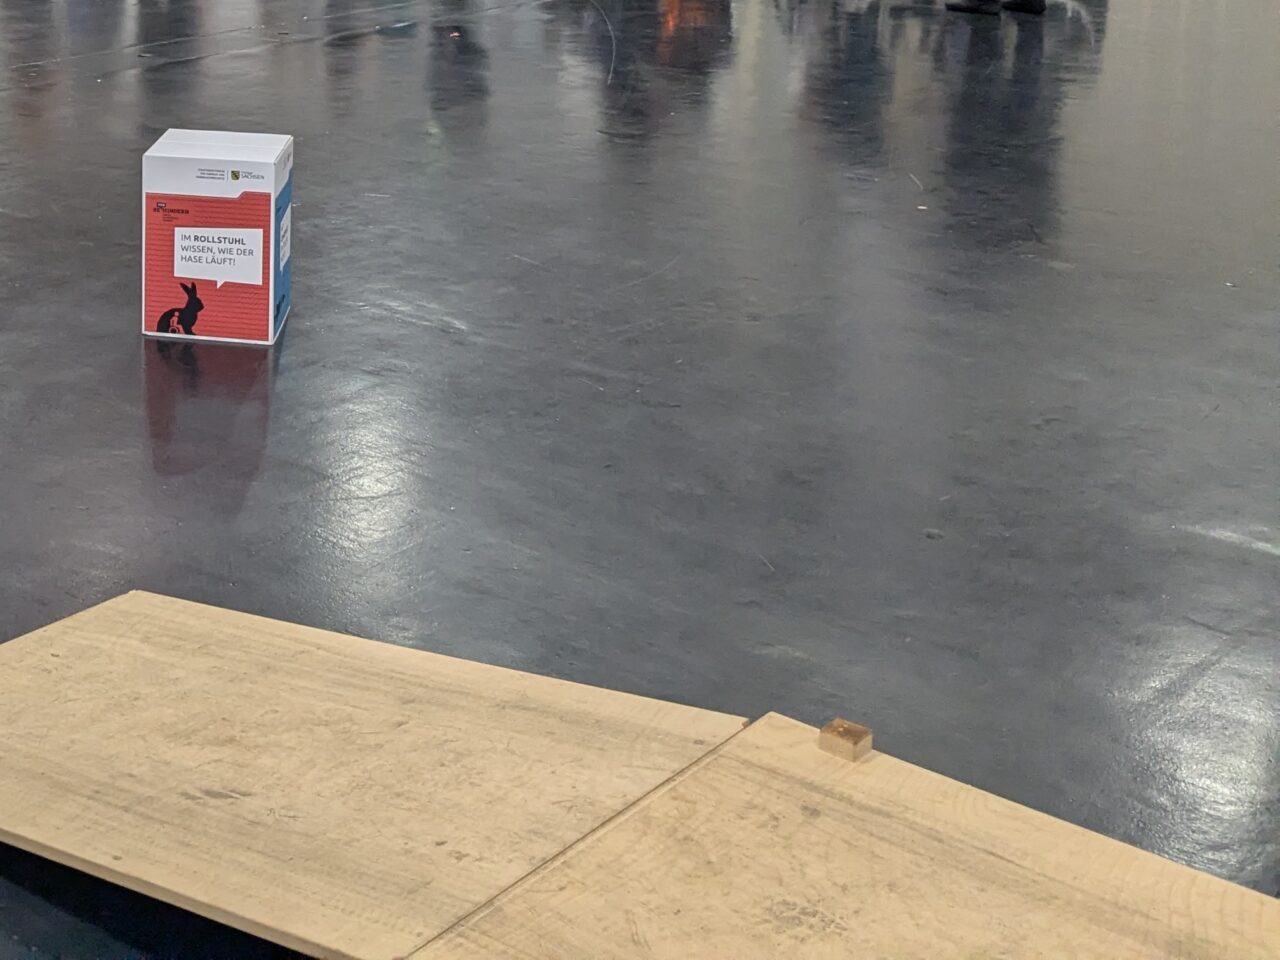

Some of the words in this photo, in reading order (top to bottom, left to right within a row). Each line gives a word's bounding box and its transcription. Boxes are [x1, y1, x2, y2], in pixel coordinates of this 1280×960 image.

[180, 234, 192, 242] IM
[193, 235, 246, 246] ROLLSTUHL
[180, 244, 216, 255] WISSEN,
[217, 247, 234, 255] WIE
[235, 248, 254, 257] DER
[180, 254, 204, 264] HASE
[205, 255, 236, 266] LÄUFT!
